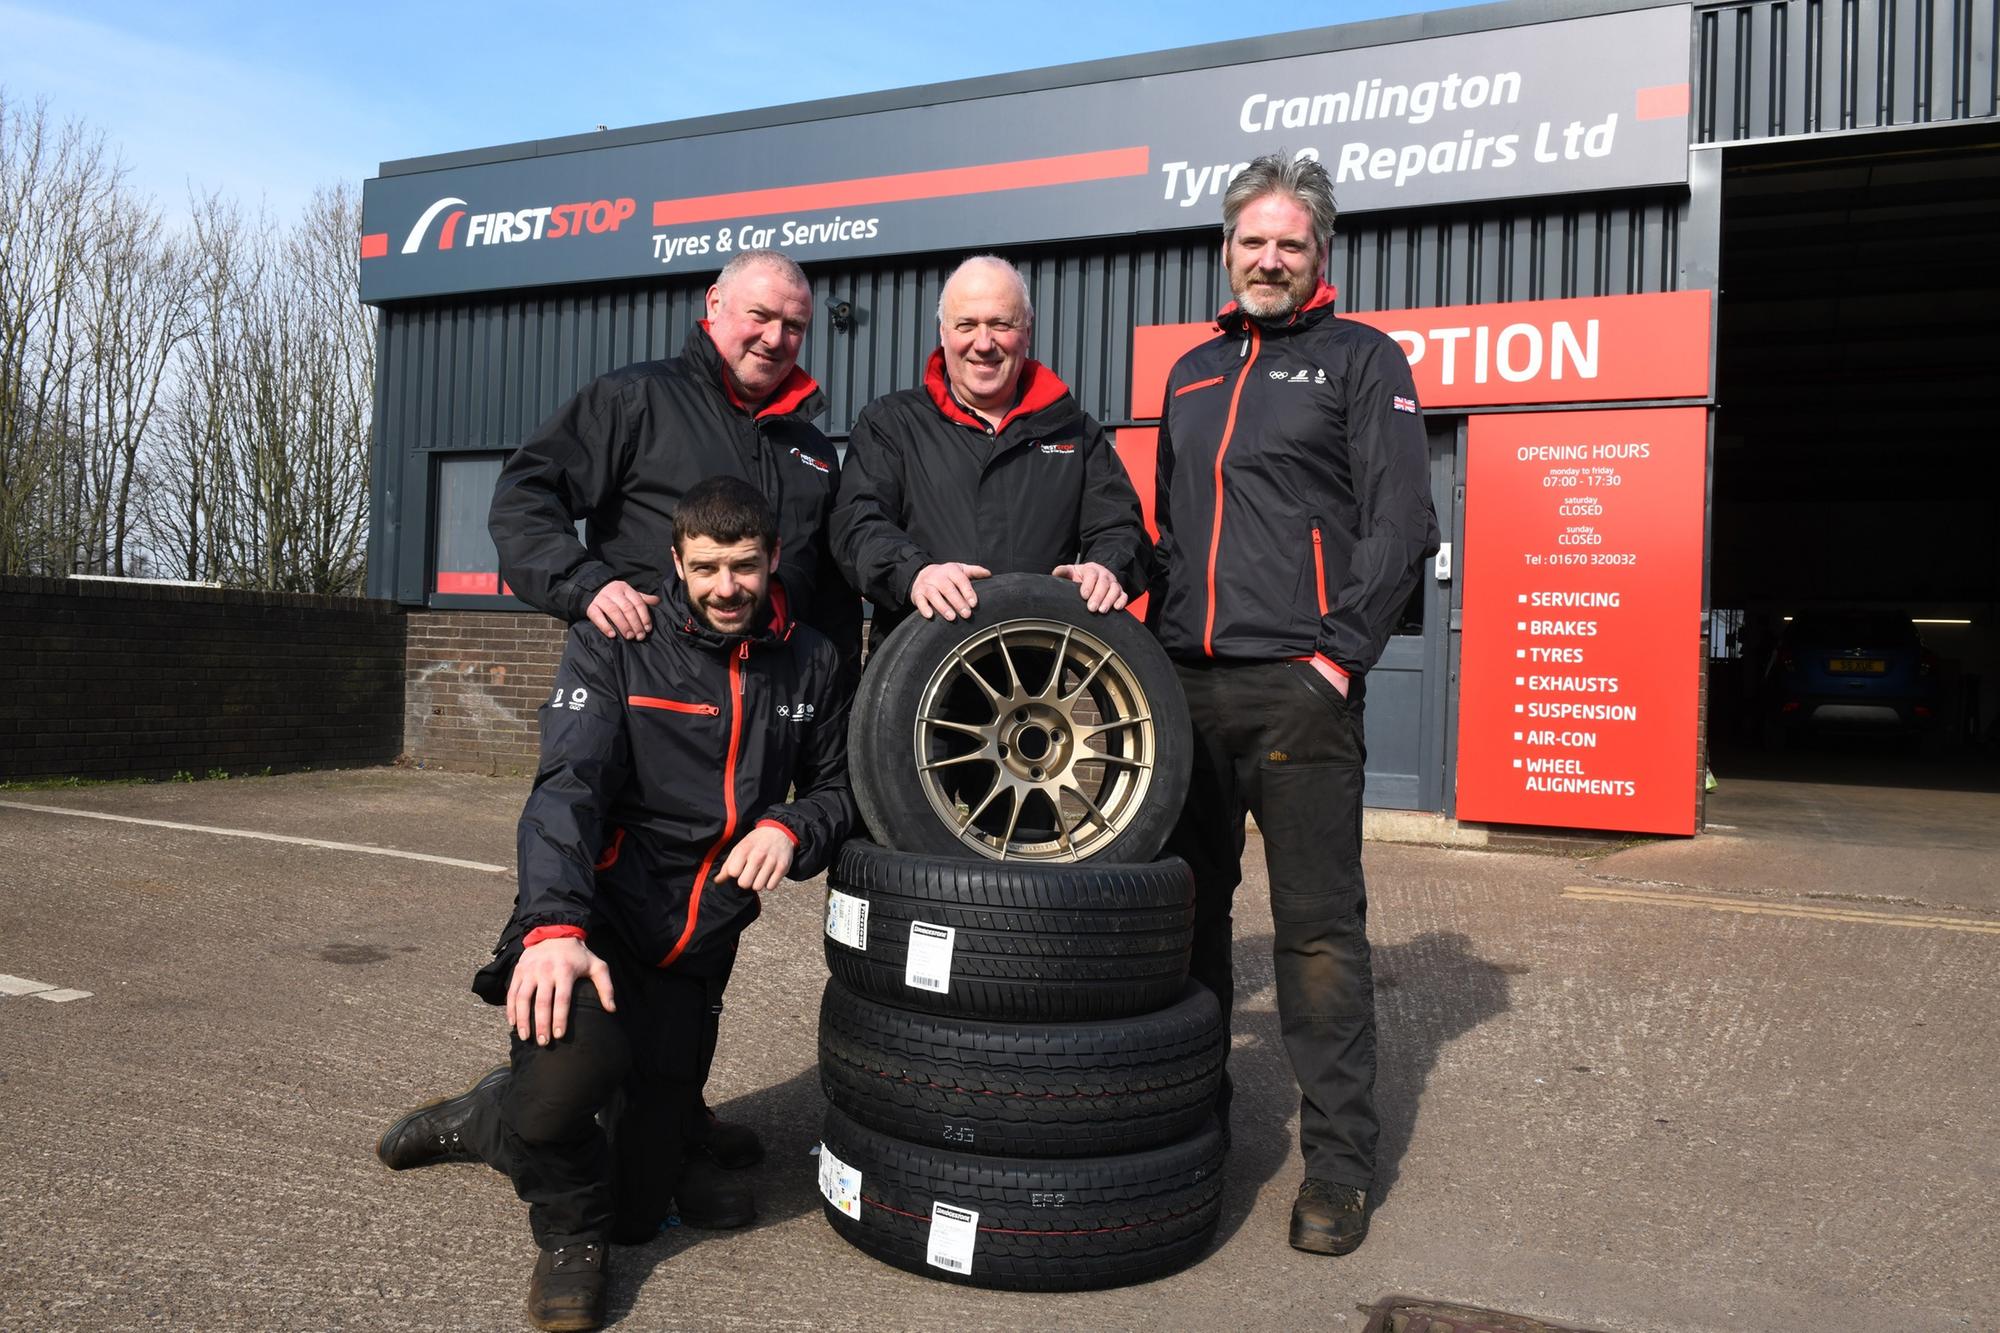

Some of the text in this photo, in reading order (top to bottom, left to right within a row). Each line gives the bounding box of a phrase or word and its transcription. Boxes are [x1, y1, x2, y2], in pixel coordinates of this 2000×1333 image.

[1239, 71, 1522, 133] Cramlington
[1161, 112, 1619, 209] Tyr Repairs Ltd
[466, 197, 637, 248] FIRSTSTOP
[652, 215, 880, 264] Tyres & Car Services
[1517, 443, 1650, 461] OPENING HOURS
[1549, 466, 1614, 476] monday to friday
[1543, 476, 1577, 487] 07:00
[1588, 475, 1621, 486] 17:30
[1564, 496, 1598, 505] saturday
[1559, 505, 1603, 516] CLOSED
[1558, 533, 1602, 545] CLOSED
[1566, 525, 1594, 536] sunday
[1524, 554, 1542, 565] Tel
[1549, 553, 1588, 565] 01670
[1591, 553, 1637, 565] 320032
[1531, 591, 1620, 608] SERVICING
[1530, 620, 1597, 636] BRAKES
[1529, 647, 1584, 663] TYRES
[1528, 675, 1618, 693] EXHAUSTS
[1528, 702, 1637, 721] SUSPENSION
[1526, 730, 1597, 748] AIR-CON
[1526, 757, 1585, 775] WHEEL
[1525, 776, 1635, 797] ALIGNMENTS
